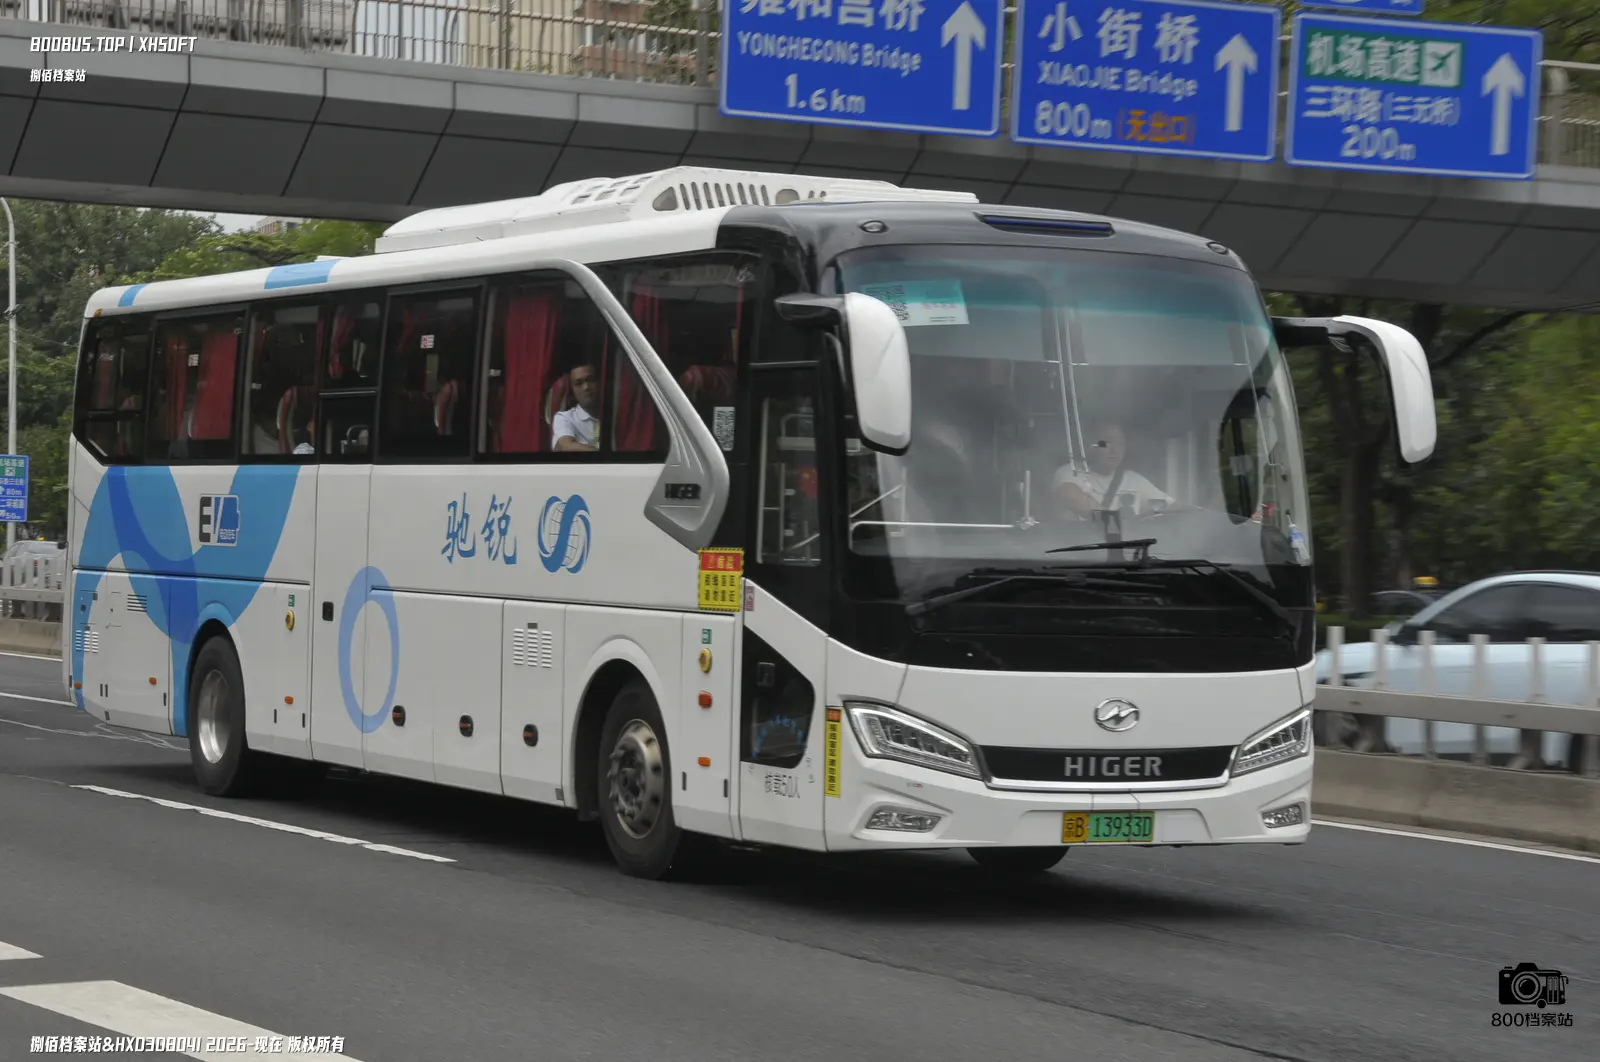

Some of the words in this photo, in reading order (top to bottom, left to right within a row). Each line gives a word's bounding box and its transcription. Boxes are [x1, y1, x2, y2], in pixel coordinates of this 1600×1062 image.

[737, 31, 859, 64] YONGHEGONG
[861, 43, 922, 77] Bridge
[1037, 1, 1200, 65] 小街桥
[1307, 32, 1420, 82] 机场高速
[1037, 60, 1123, 91] XIAOJIE
[1125, 70, 1199, 103] Bridge
[1035, 99, 1113, 139] 800m
[1340, 124, 1417, 161] 200m
[1064, 756, 1163, 777] HIGER
